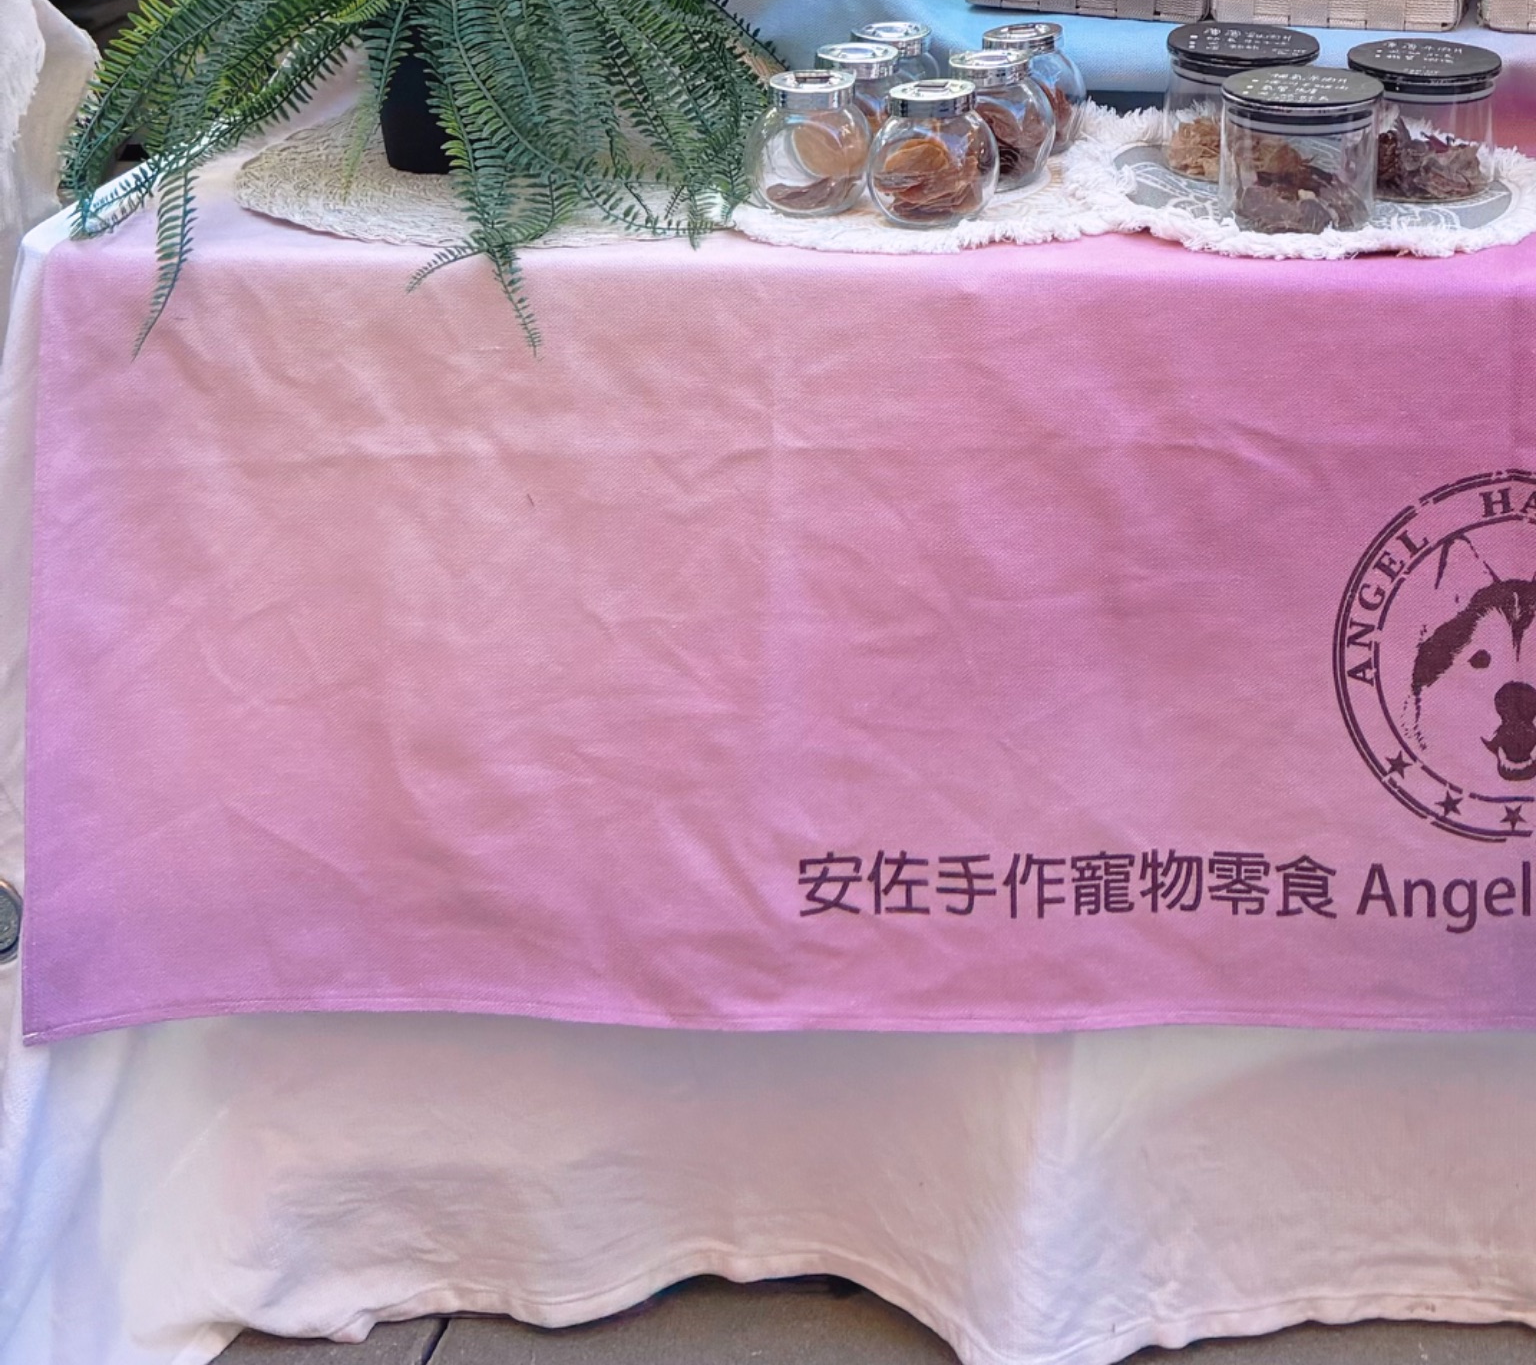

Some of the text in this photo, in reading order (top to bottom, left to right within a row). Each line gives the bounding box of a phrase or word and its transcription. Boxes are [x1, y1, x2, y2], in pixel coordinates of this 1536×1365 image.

[1346, 529, 1431, 687] ANGEL
[798, 849, 1338, 919] 安佐手作寵物零食
[1356, 861, 1534, 934] Angel
